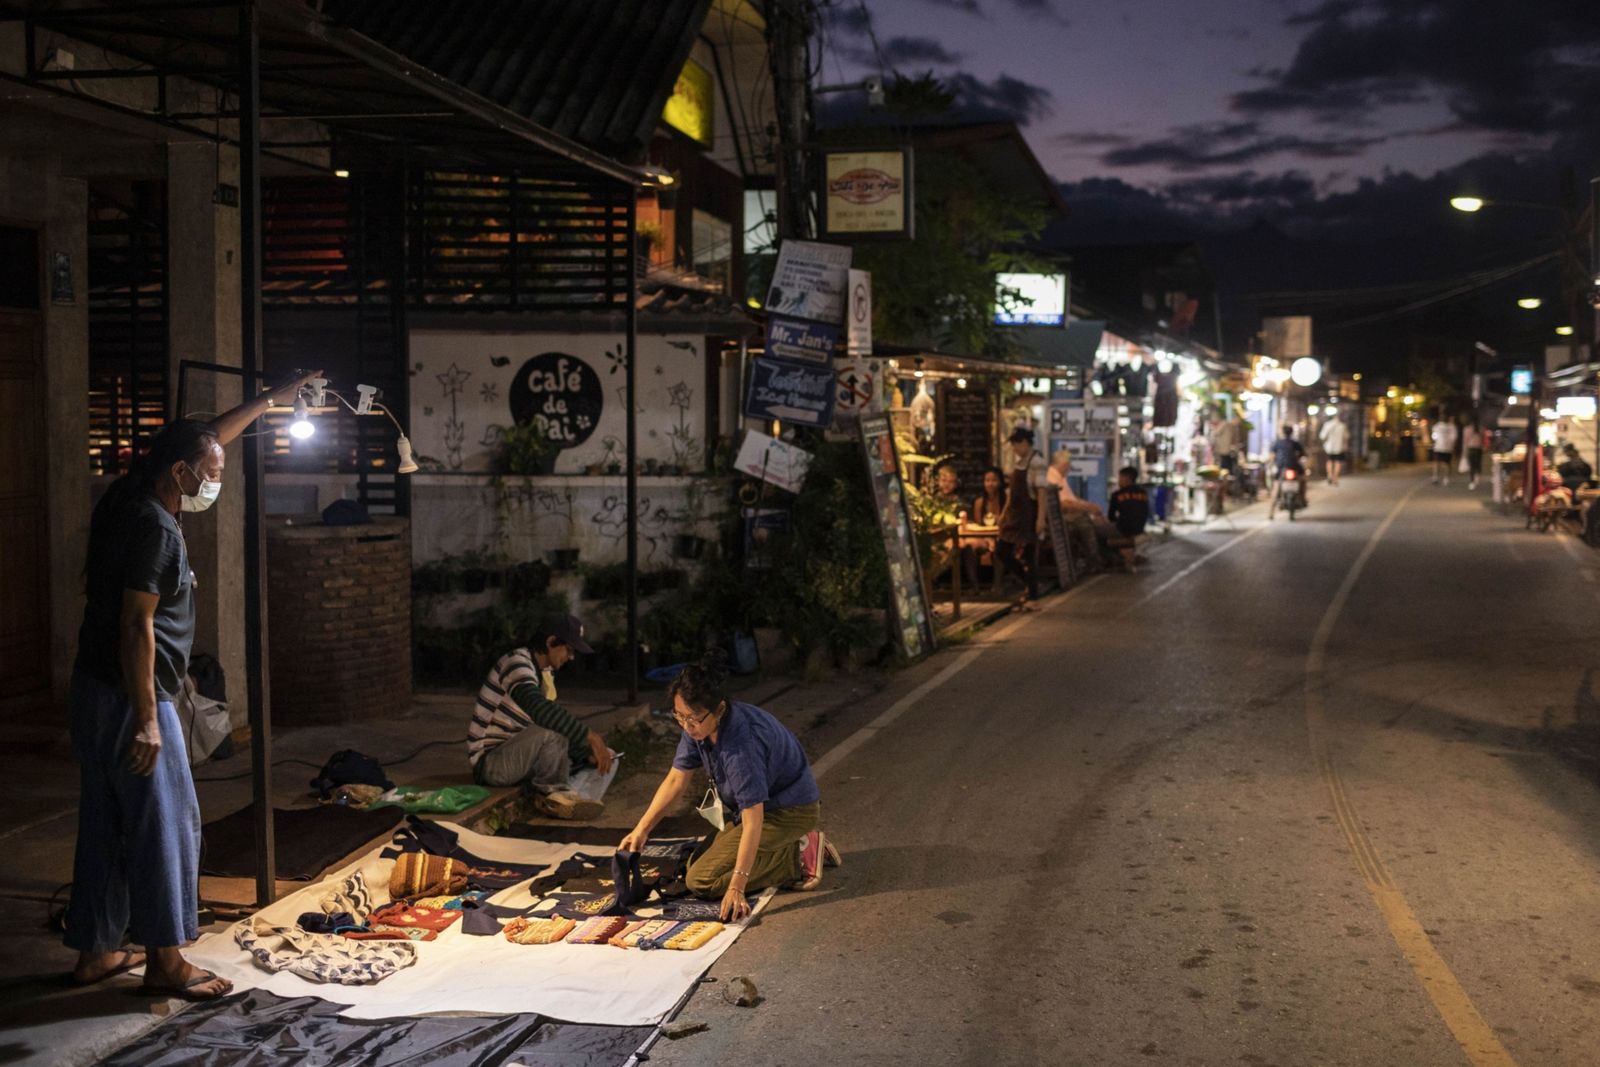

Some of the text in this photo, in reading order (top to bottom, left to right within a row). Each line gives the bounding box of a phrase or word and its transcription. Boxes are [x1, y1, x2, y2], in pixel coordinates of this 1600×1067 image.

[770, 325, 793, 344] Mr.
[797, 331, 833, 351] Jan's
[543, 394, 568, 414] de
